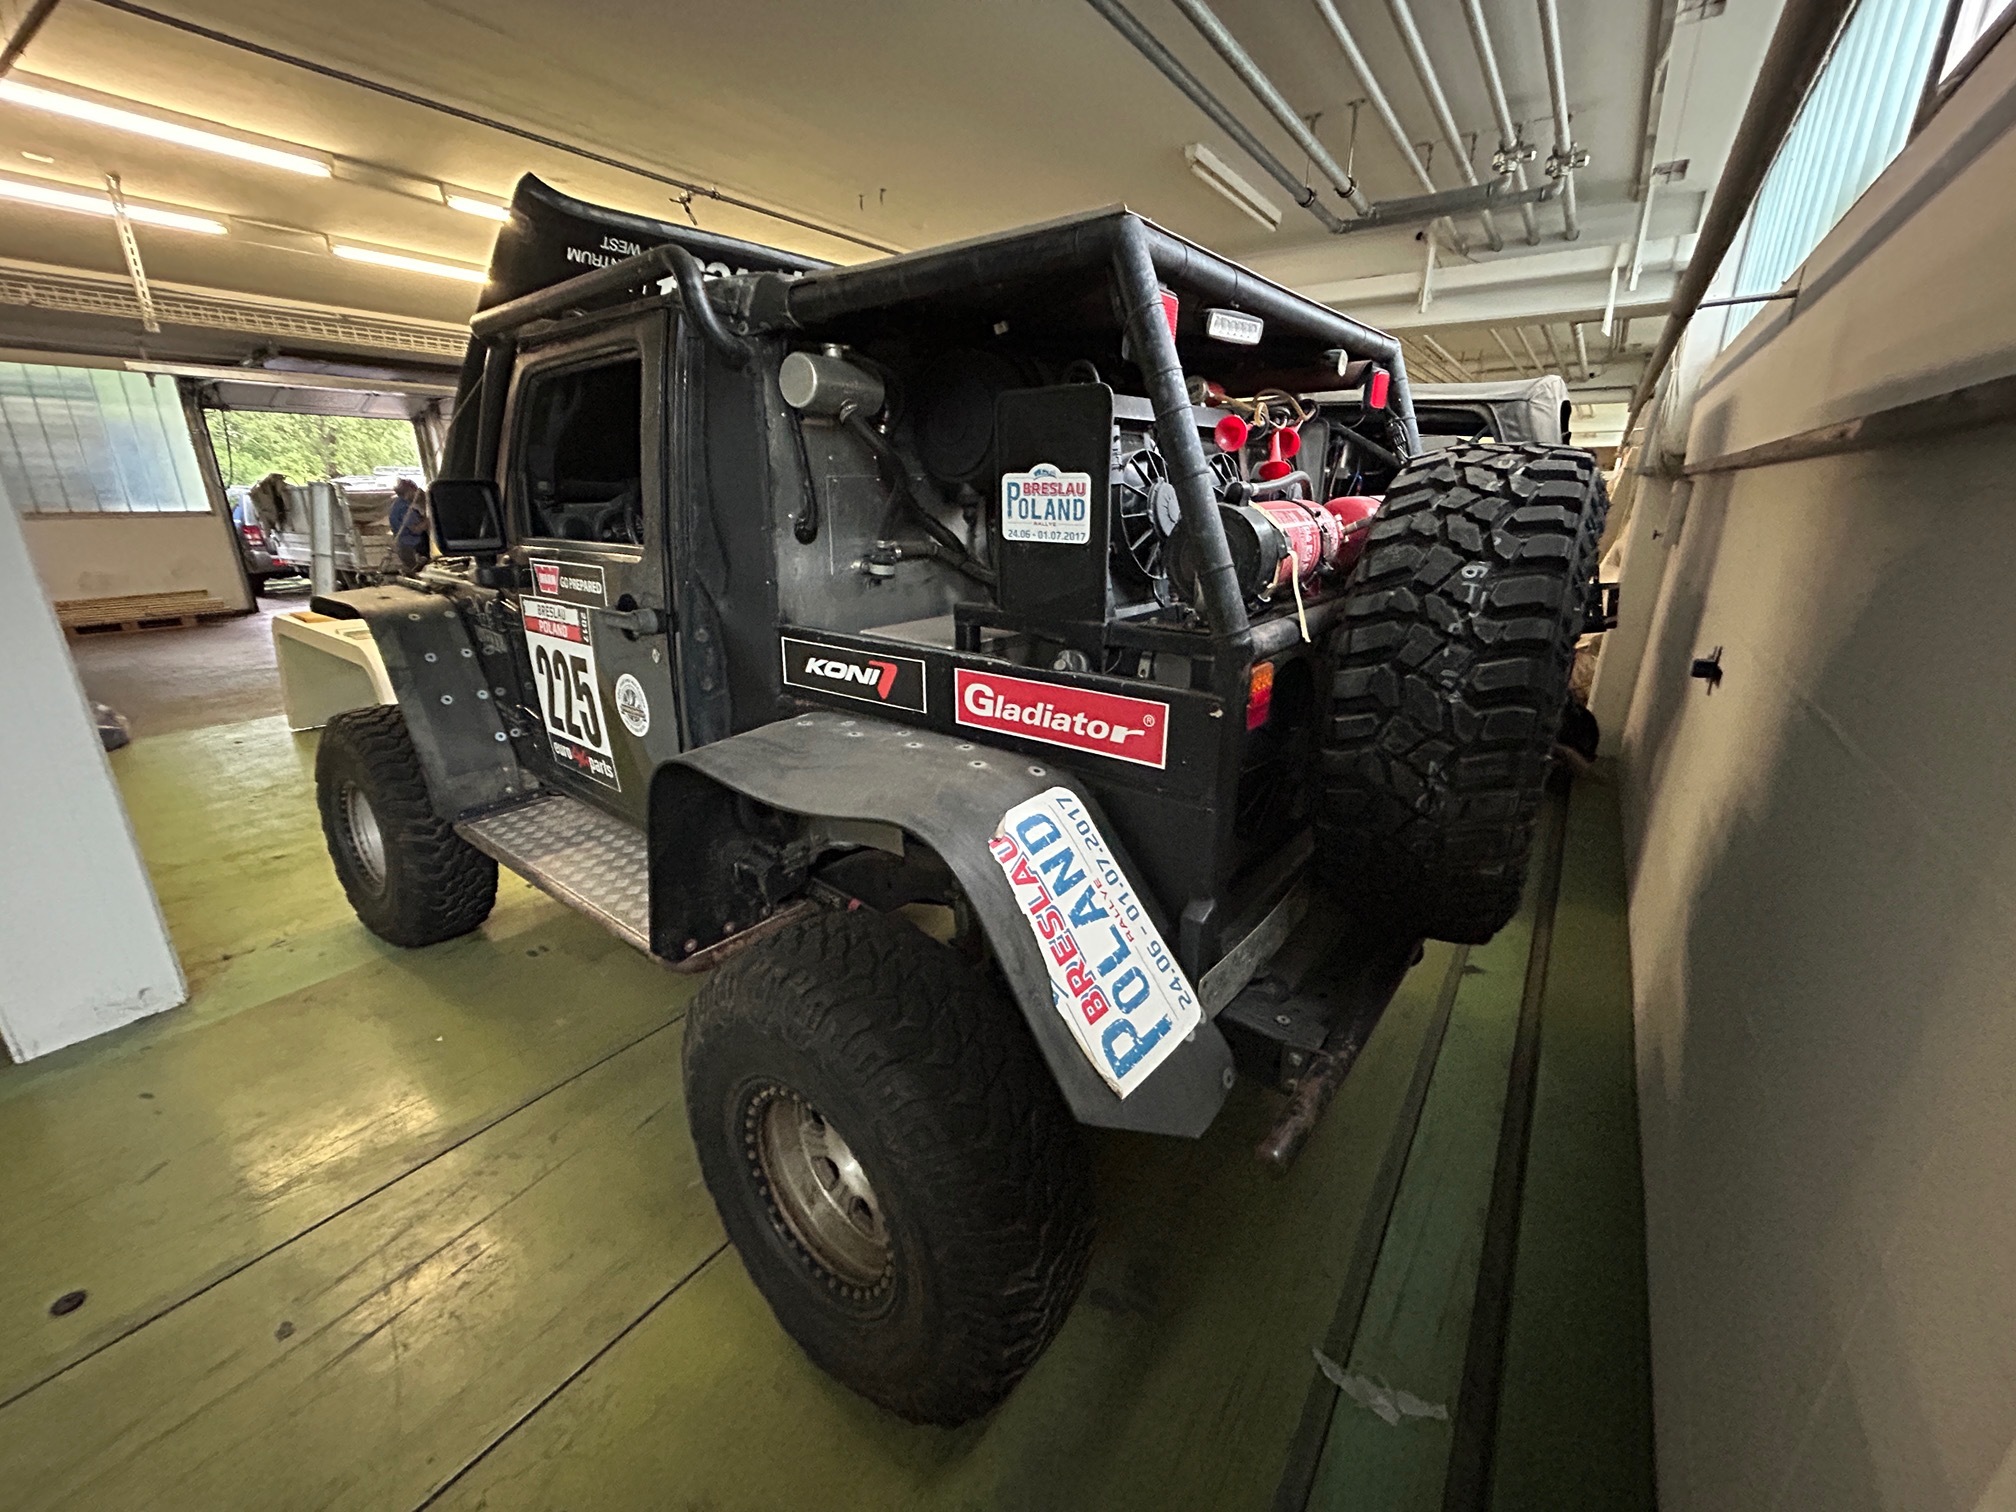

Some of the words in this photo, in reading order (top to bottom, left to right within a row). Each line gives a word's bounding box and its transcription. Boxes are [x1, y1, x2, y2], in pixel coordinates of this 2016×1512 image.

[566, 246, 617, 269] TRUM
[600, 236, 641, 256] WEST
[1007, 482, 1086, 521] POLAND
[1023, 482, 1086, 496] BRESLAU
[1008, 529, 1031, 539] 24.06
[1037, 530, 1086, 541] 01.07.2017
[560, 576, 569, 588] GO
[569, 577, 602, 595] PREPARED
[537, 603, 567, 621] BRESLAU
[538, 619, 568, 638] POLAND
[804, 657, 882, 687] KONI
[536, 645, 602, 749] 225
[963, 682, 1146, 745] Gladiator
[588, 756, 614, 778] parts
[1055, 796, 1140, 921] 01.07.2017
[1093, 877, 1135, 942] RALLYE
[987, 832, 1111, 1026] BRESLAU
[1015, 812, 1174, 1080] POLAND
[1146, 940, 1193, 1011] 24.06
